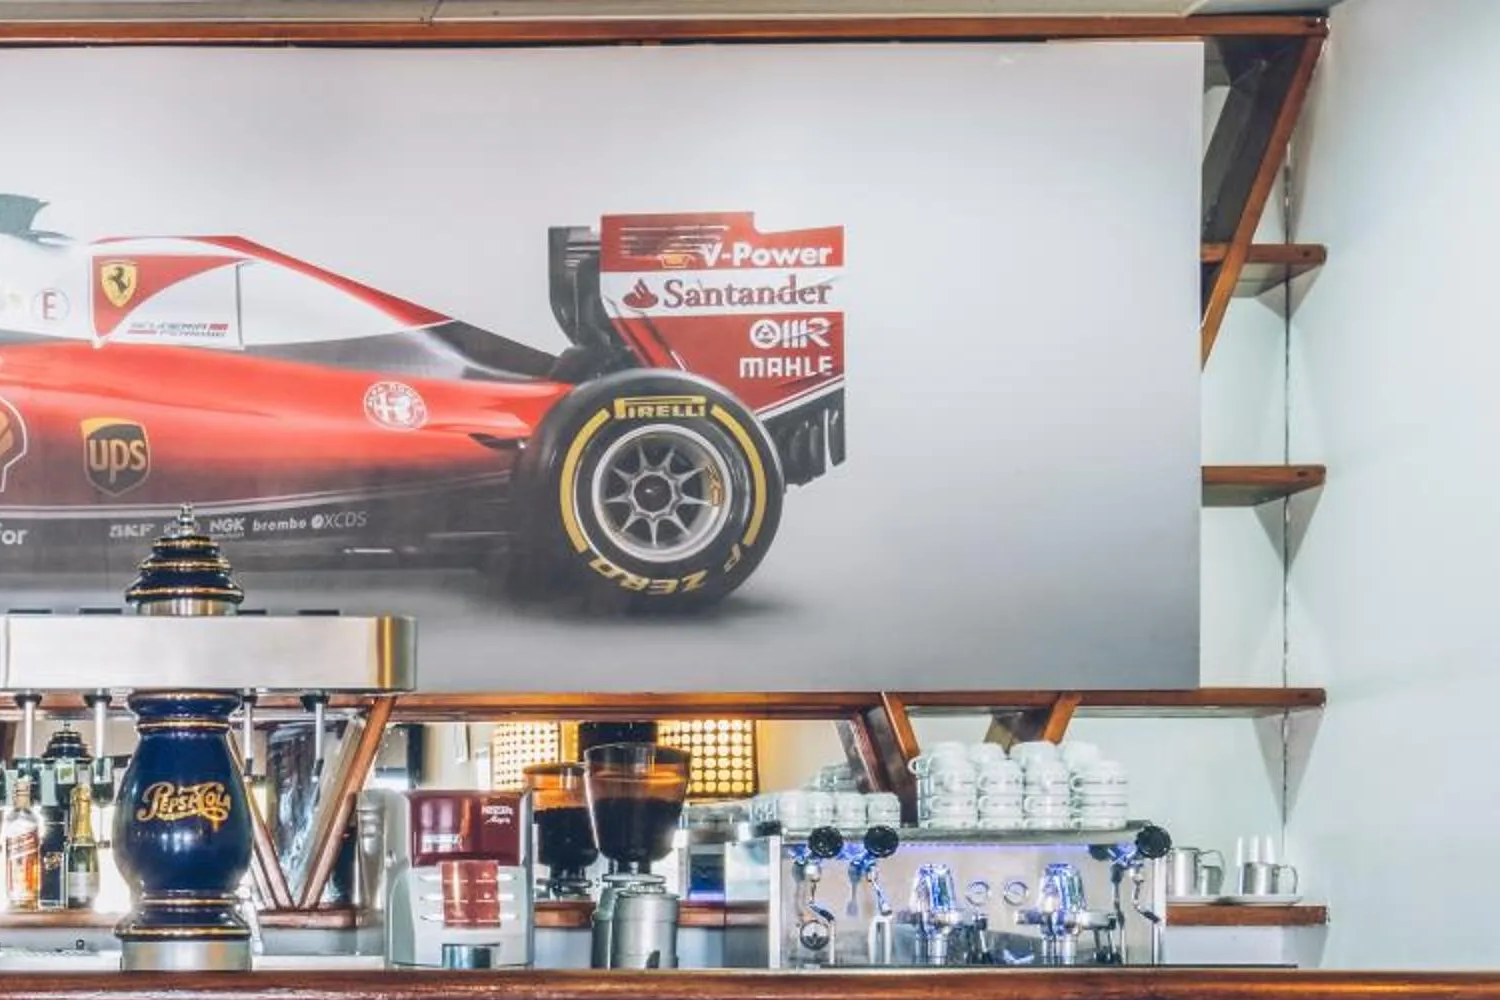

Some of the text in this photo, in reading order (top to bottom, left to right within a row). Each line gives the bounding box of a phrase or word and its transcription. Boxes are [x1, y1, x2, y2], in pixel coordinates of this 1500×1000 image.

[703, 243, 833, 266] V-Power
[663, 274, 833, 308] Santander
[739, 356, 833, 379] MAHLE
[613, 395, 706, 419] PIRELLI
[209, 518, 246, 533] NGK
[253, 516, 307, 532] brembo
[589, 558, 708, 594] ZERO
